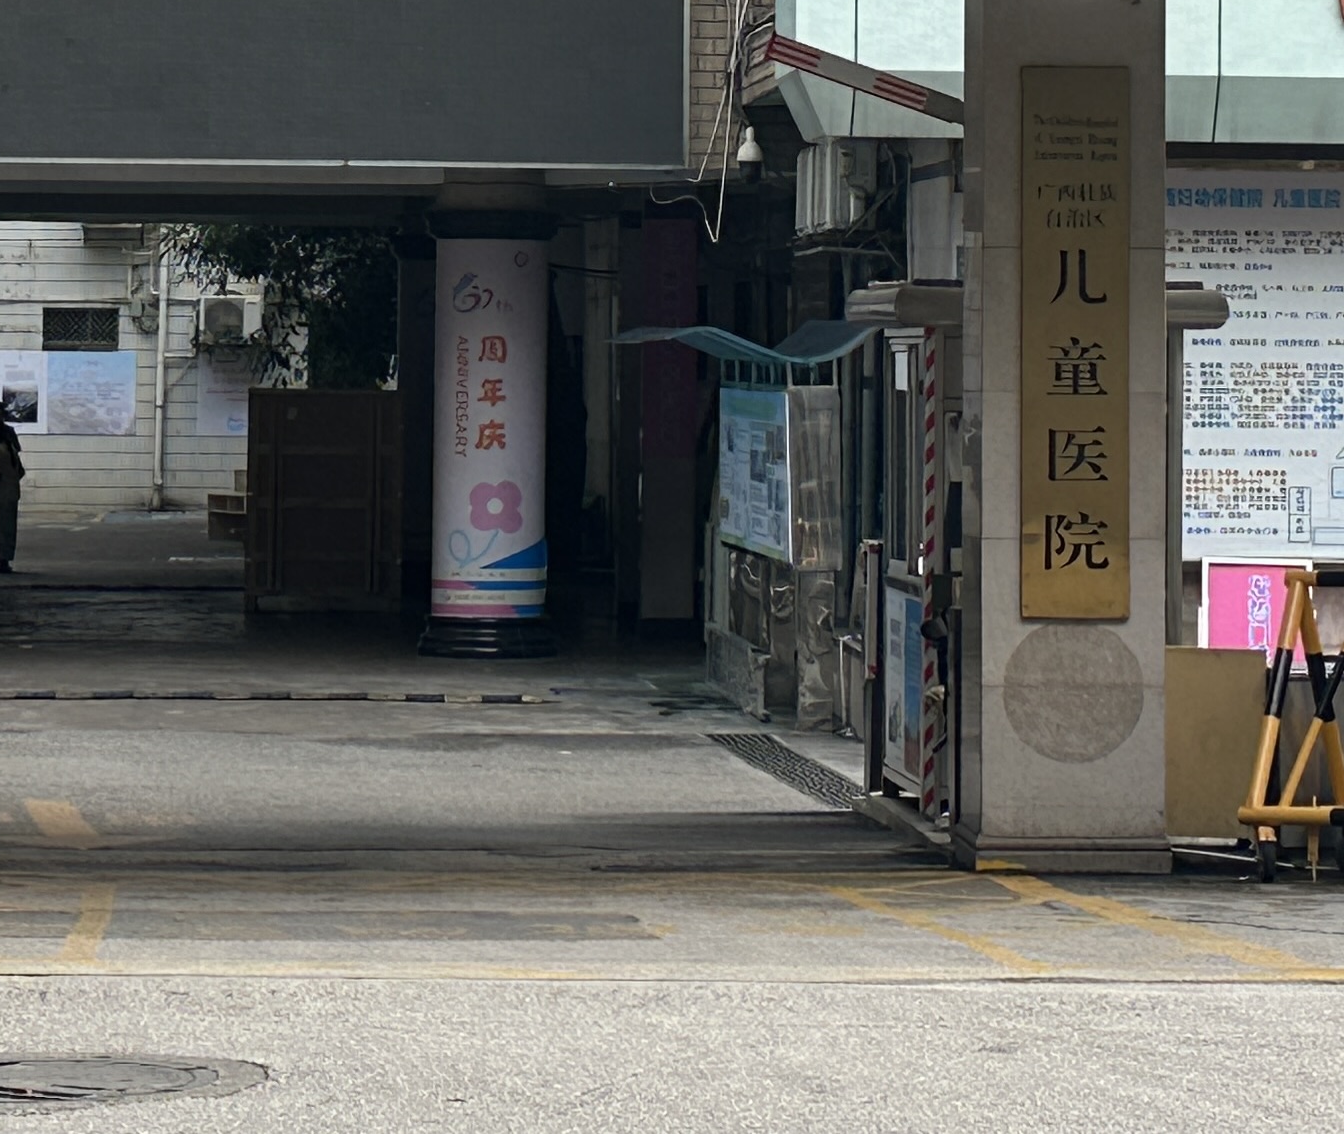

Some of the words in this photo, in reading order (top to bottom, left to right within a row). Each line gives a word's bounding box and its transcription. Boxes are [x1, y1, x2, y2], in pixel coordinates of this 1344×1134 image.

[475, 335, 507, 450] 周年庆
[1043, 248, 1110, 570] 儿童医院
